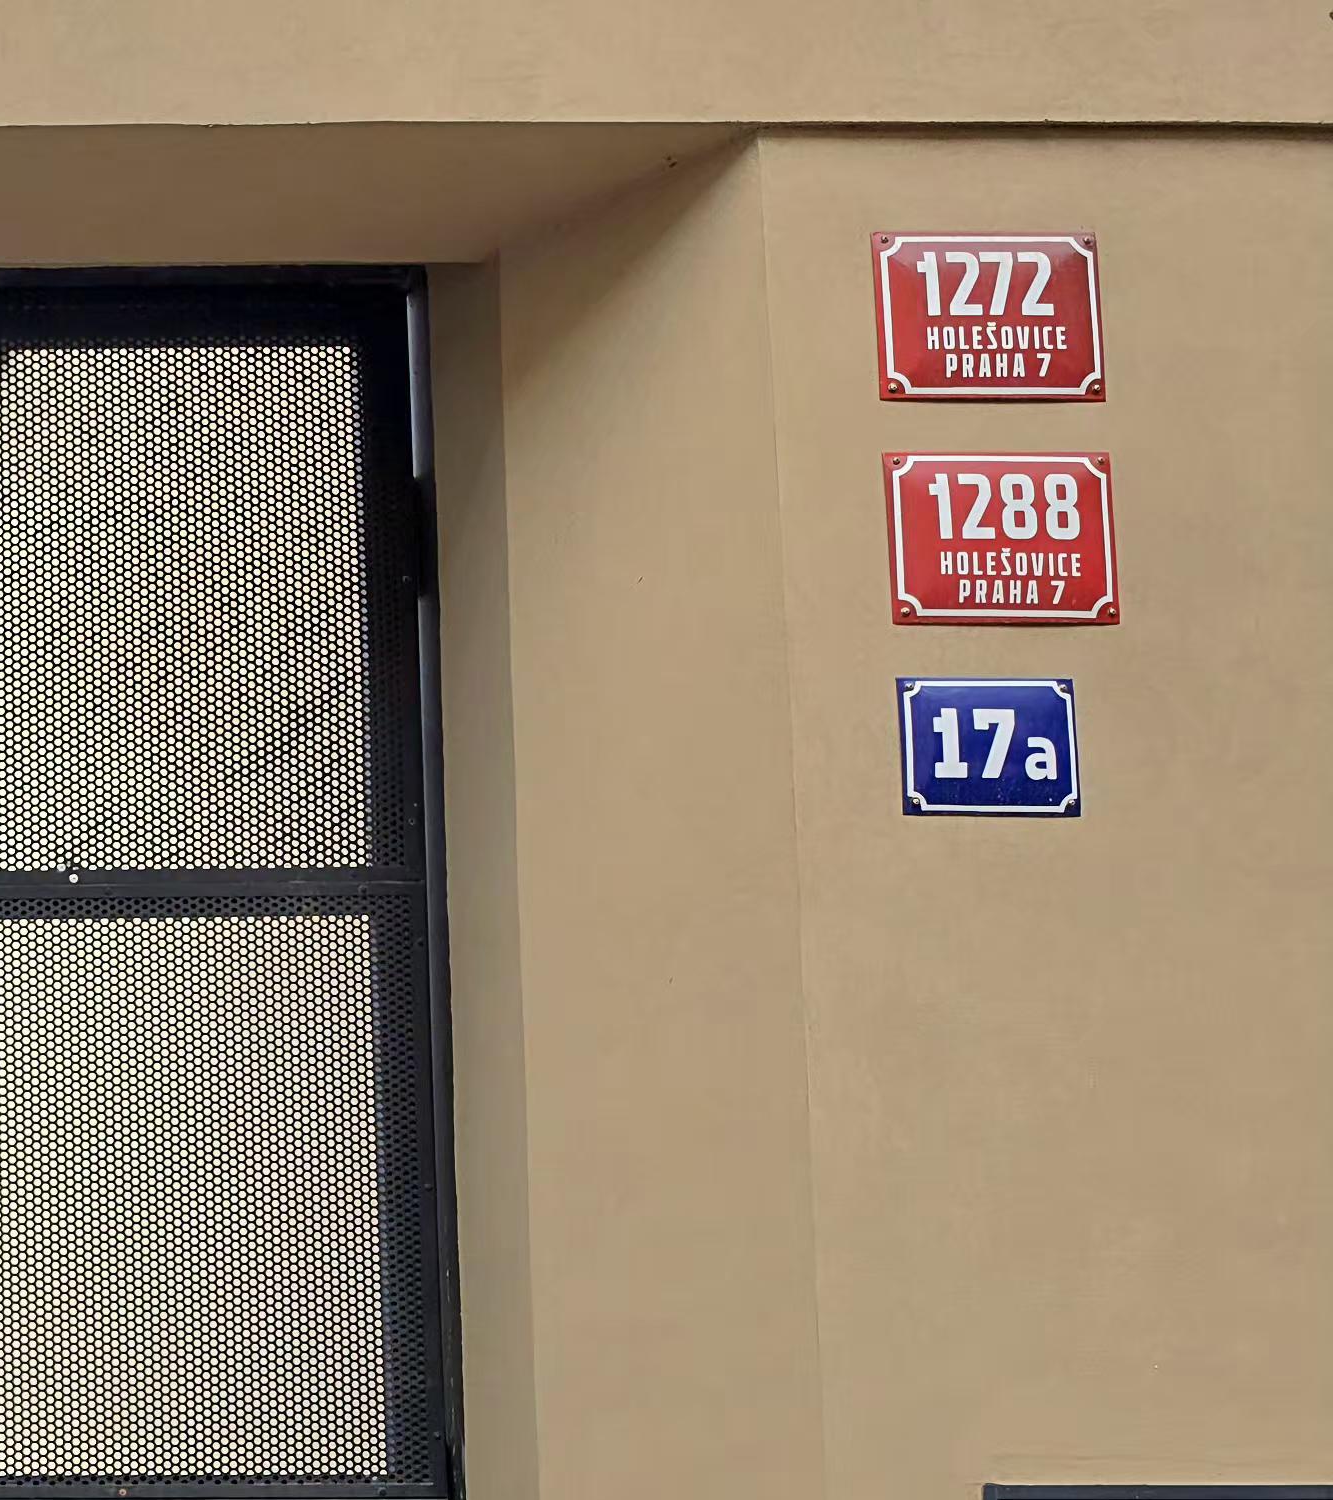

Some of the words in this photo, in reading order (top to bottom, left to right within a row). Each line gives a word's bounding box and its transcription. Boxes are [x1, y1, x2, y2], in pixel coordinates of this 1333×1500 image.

[916, 250, 1055, 317] 1272
[926, 321, 1068, 350] HOLEŠOVICE
[945, 352, 1026, 378] PRAHA
[1036, 352, 1052, 377] 7
[928, 472, 1081, 541] 1288
[940, 547, 1082, 577] HOLEŠOVICE
[958, 579, 1039, 605] PRAHA
[1050, 580, 1066, 605] 7
[932, 707, 1058, 781] 17a
